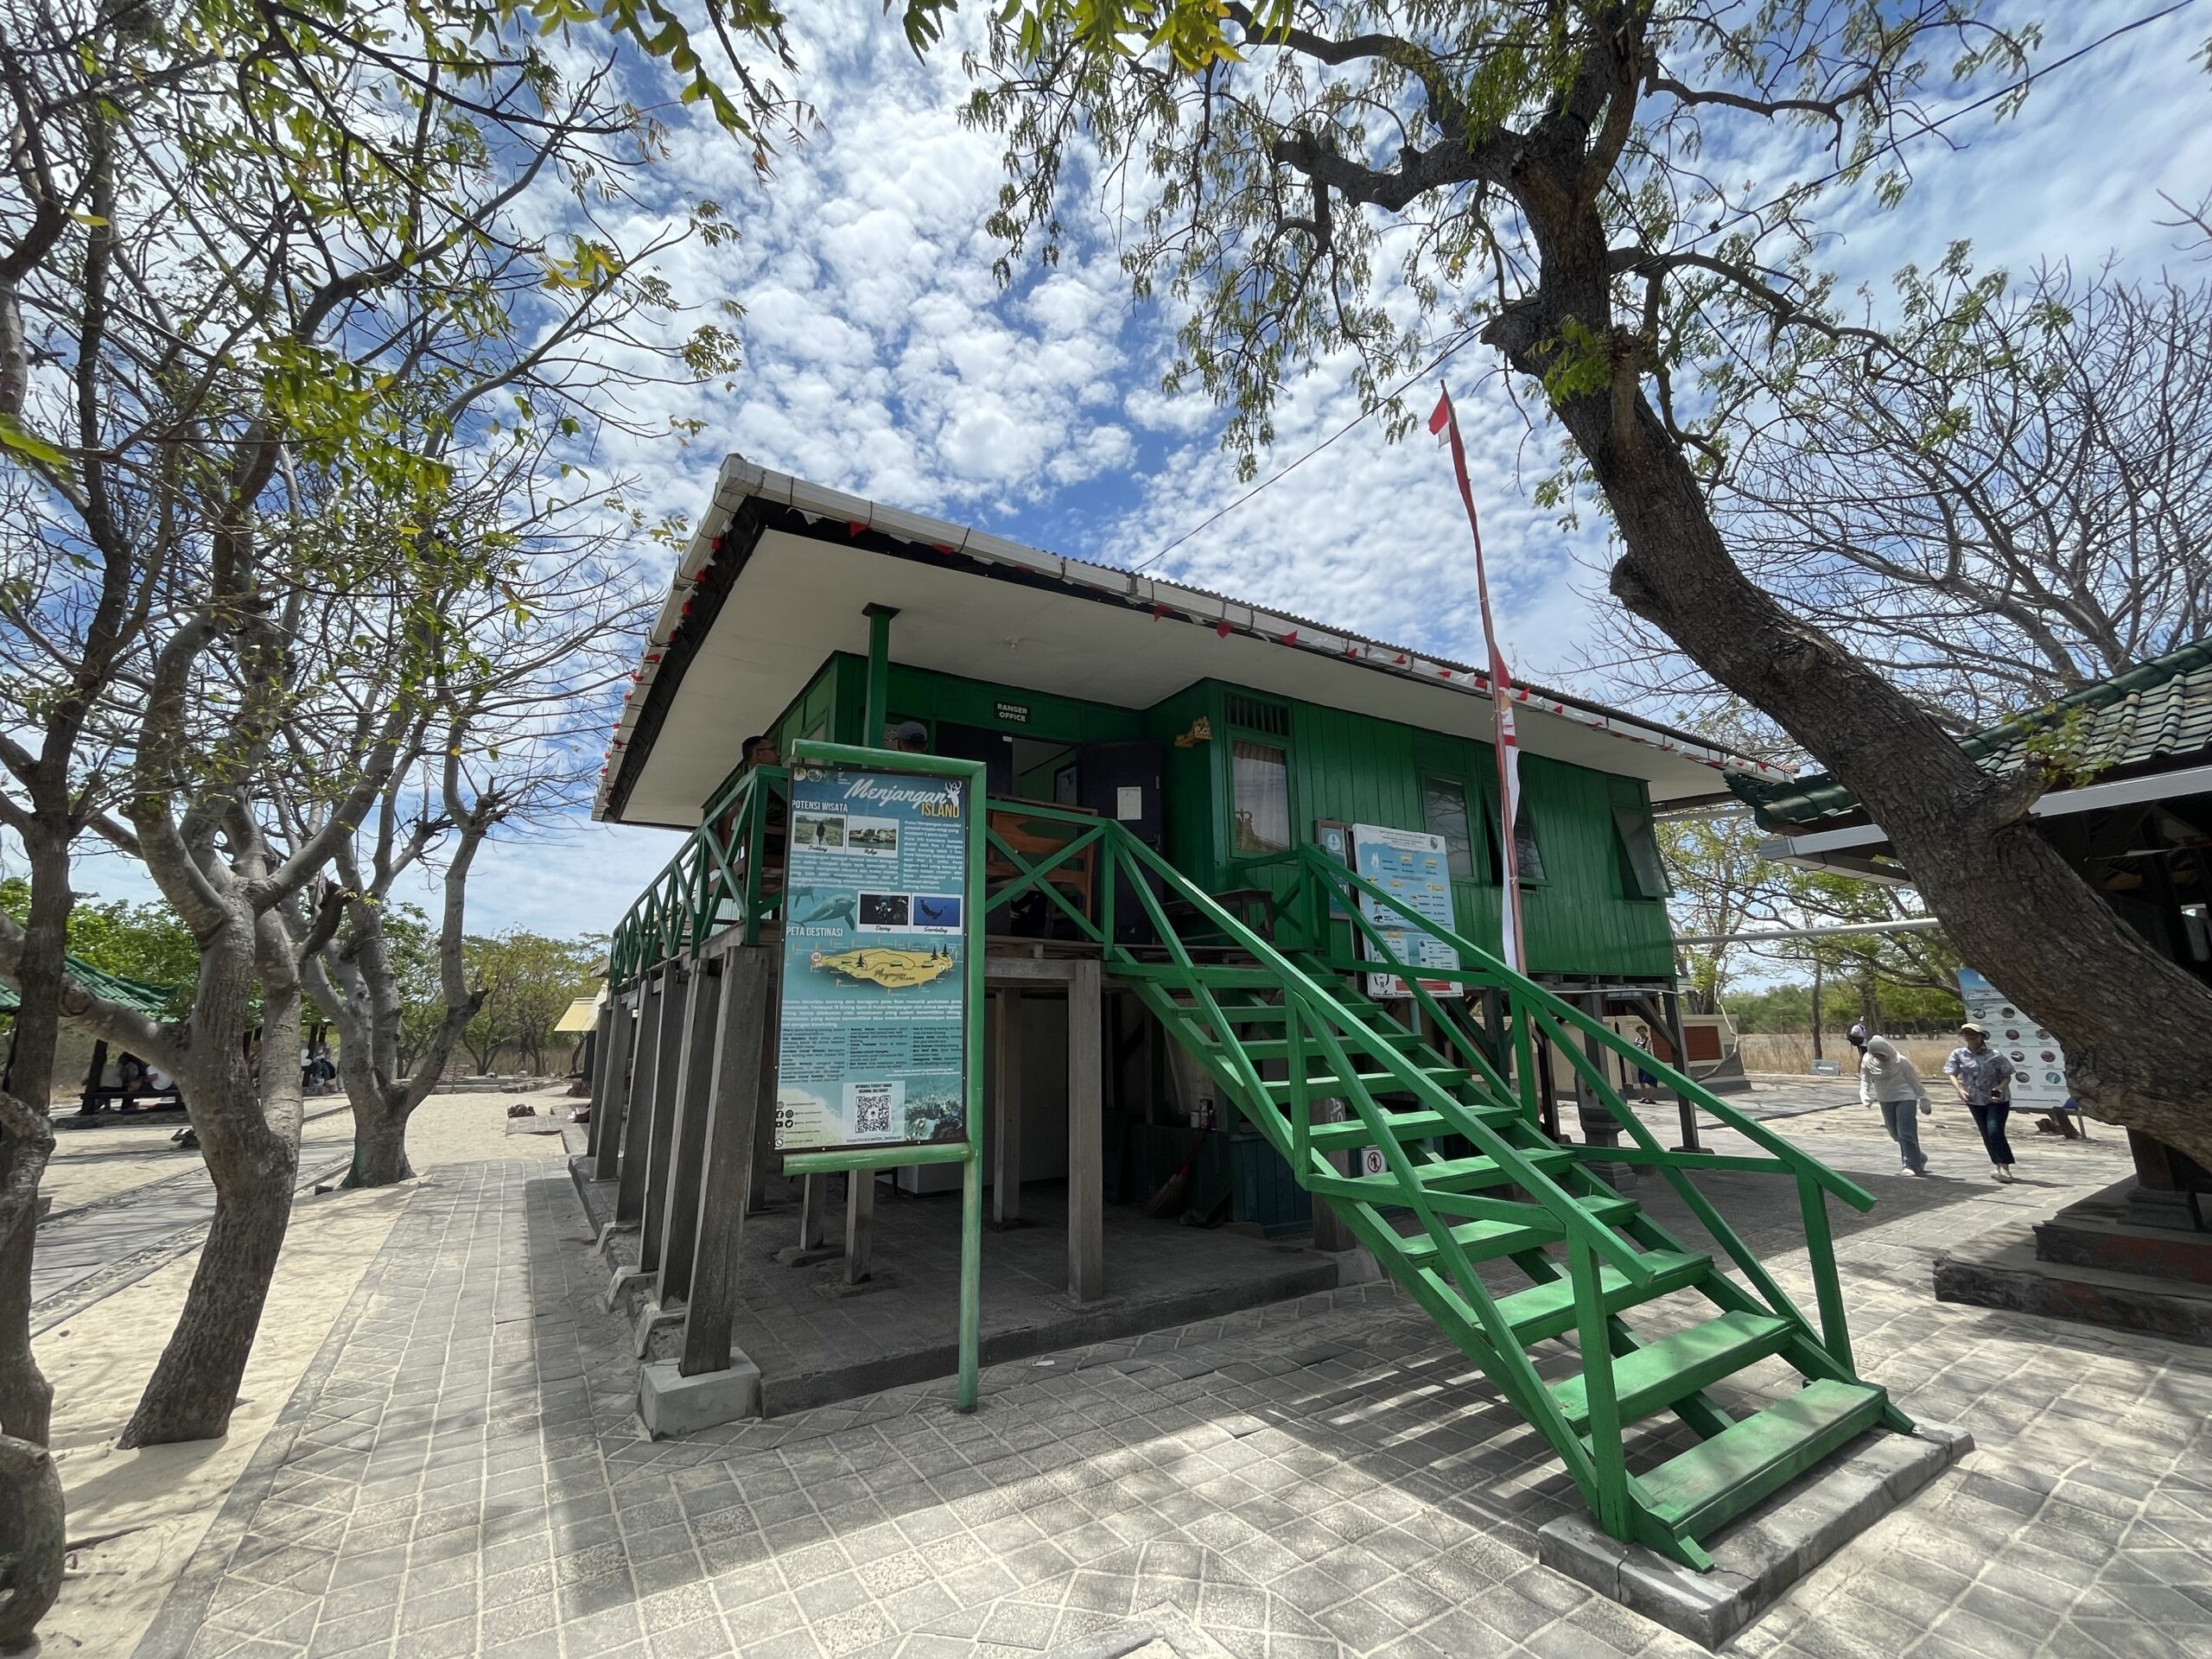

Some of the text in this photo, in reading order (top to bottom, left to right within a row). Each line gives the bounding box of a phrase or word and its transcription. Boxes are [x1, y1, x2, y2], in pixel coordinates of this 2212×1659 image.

[997, 703, 1027, 715] RANGER
[999, 711, 1026, 722] OFFICE
[843, 779, 947, 810] Menjangan
[791, 800, 849, 813] POTENSI WISATA
[921, 802, 960, 818] ISLAND
[786, 926, 843, 938] PETA DESTINASI
